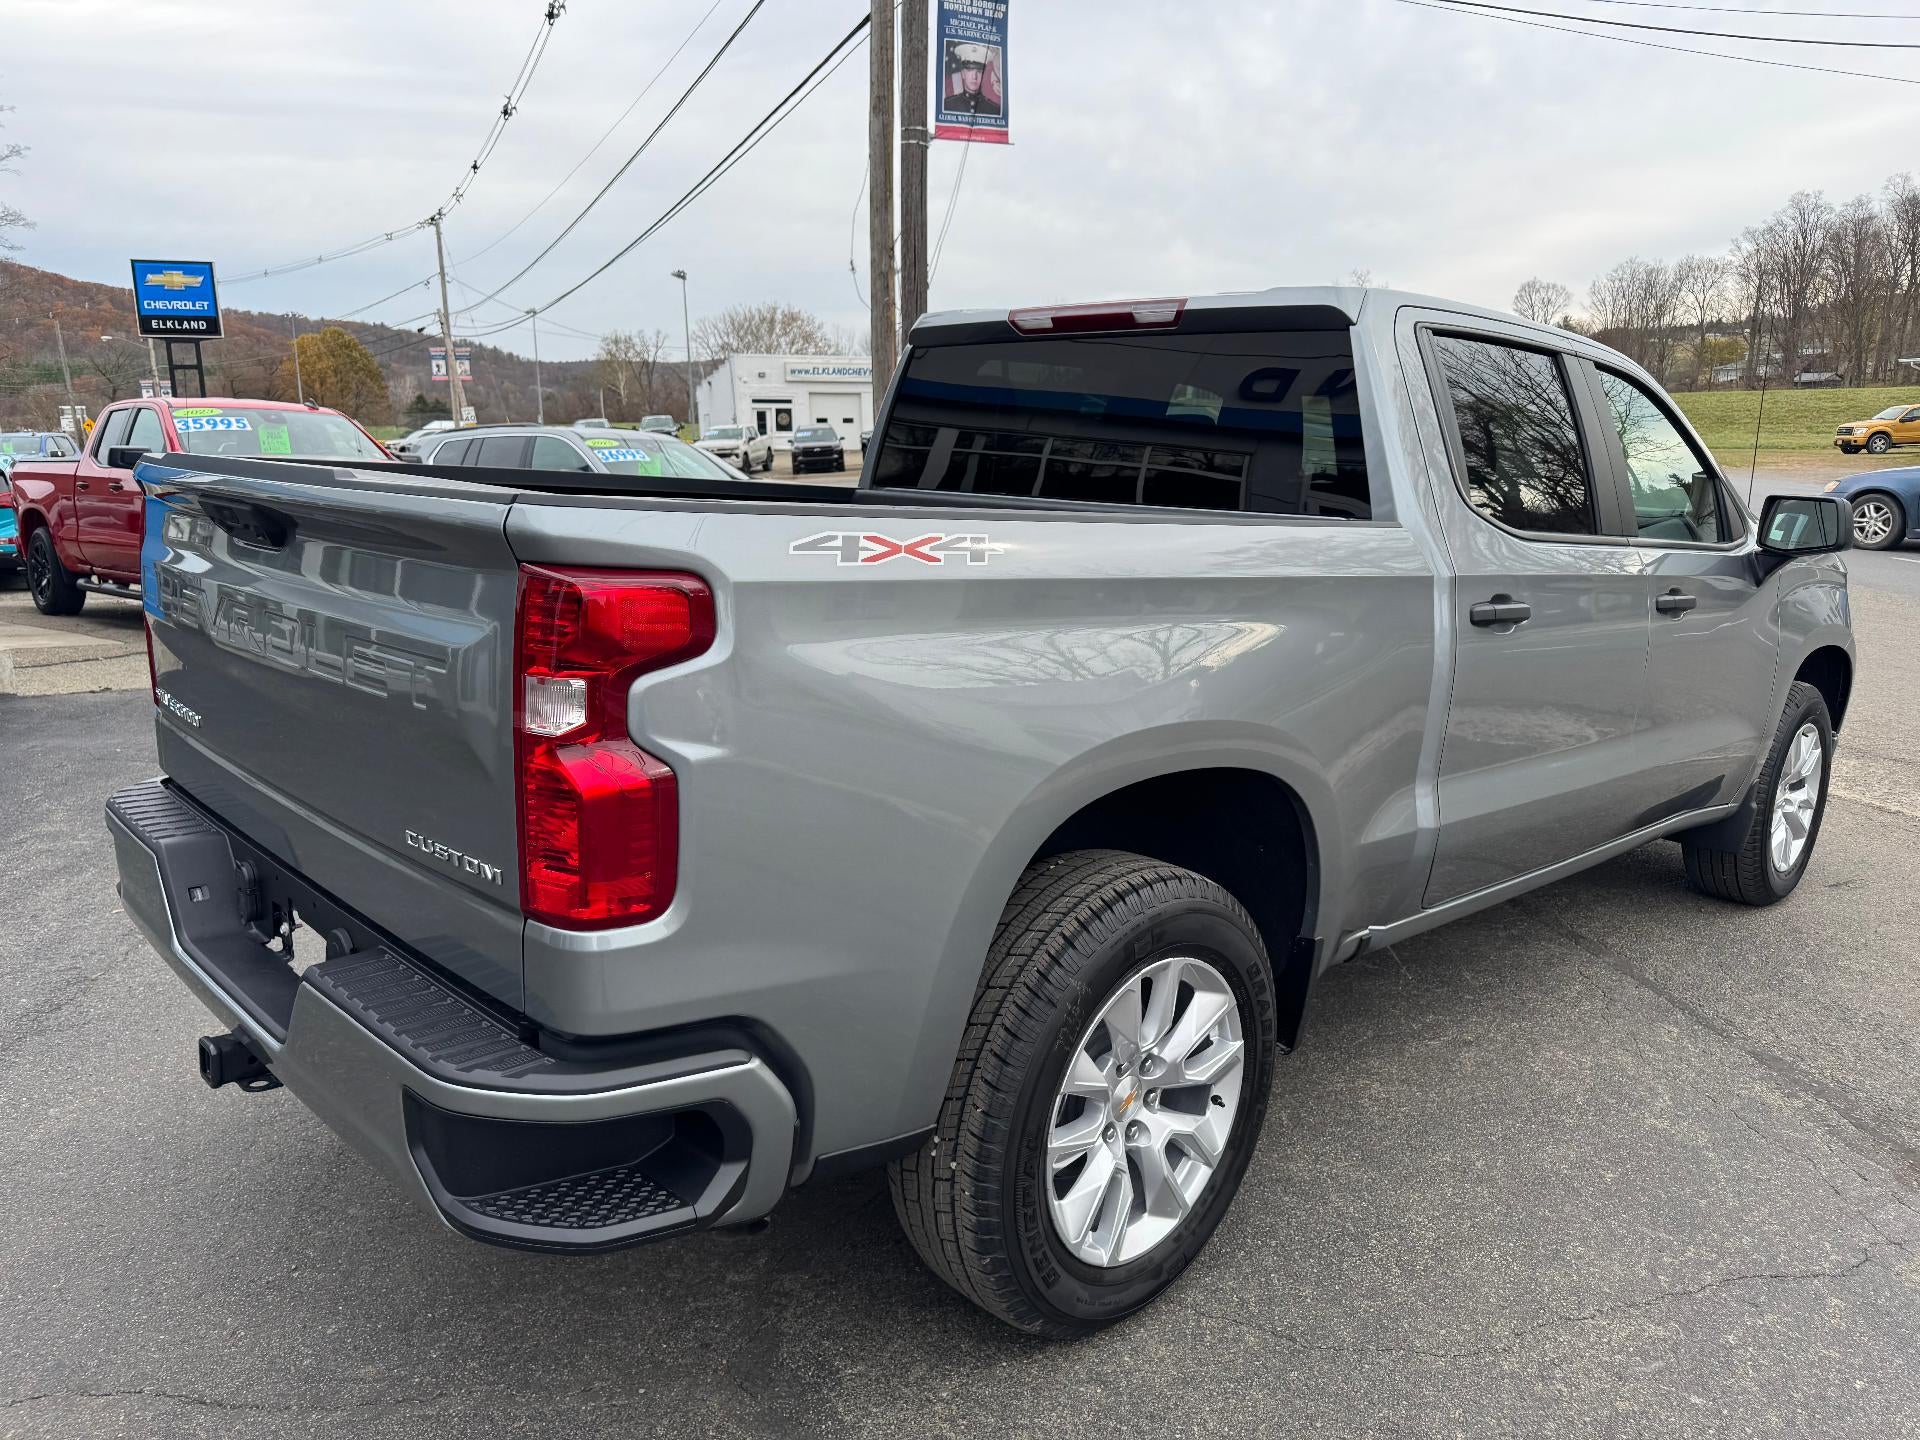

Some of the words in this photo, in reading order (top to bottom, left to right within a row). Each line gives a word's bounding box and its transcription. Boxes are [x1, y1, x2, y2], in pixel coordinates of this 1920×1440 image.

[944, 2, 983, 15] HOMETOWN
[950, 18, 977, 29] MICHAEL
[957, 29, 981, 39] MARINE
[144, 300, 209, 310] CHEVROLET
[151, 319, 207, 330] ELKLAND
[176, 418, 248, 432] 35995
[597, 449, 646, 461] 36995
[405, 829, 504, 886] CUSTOM
